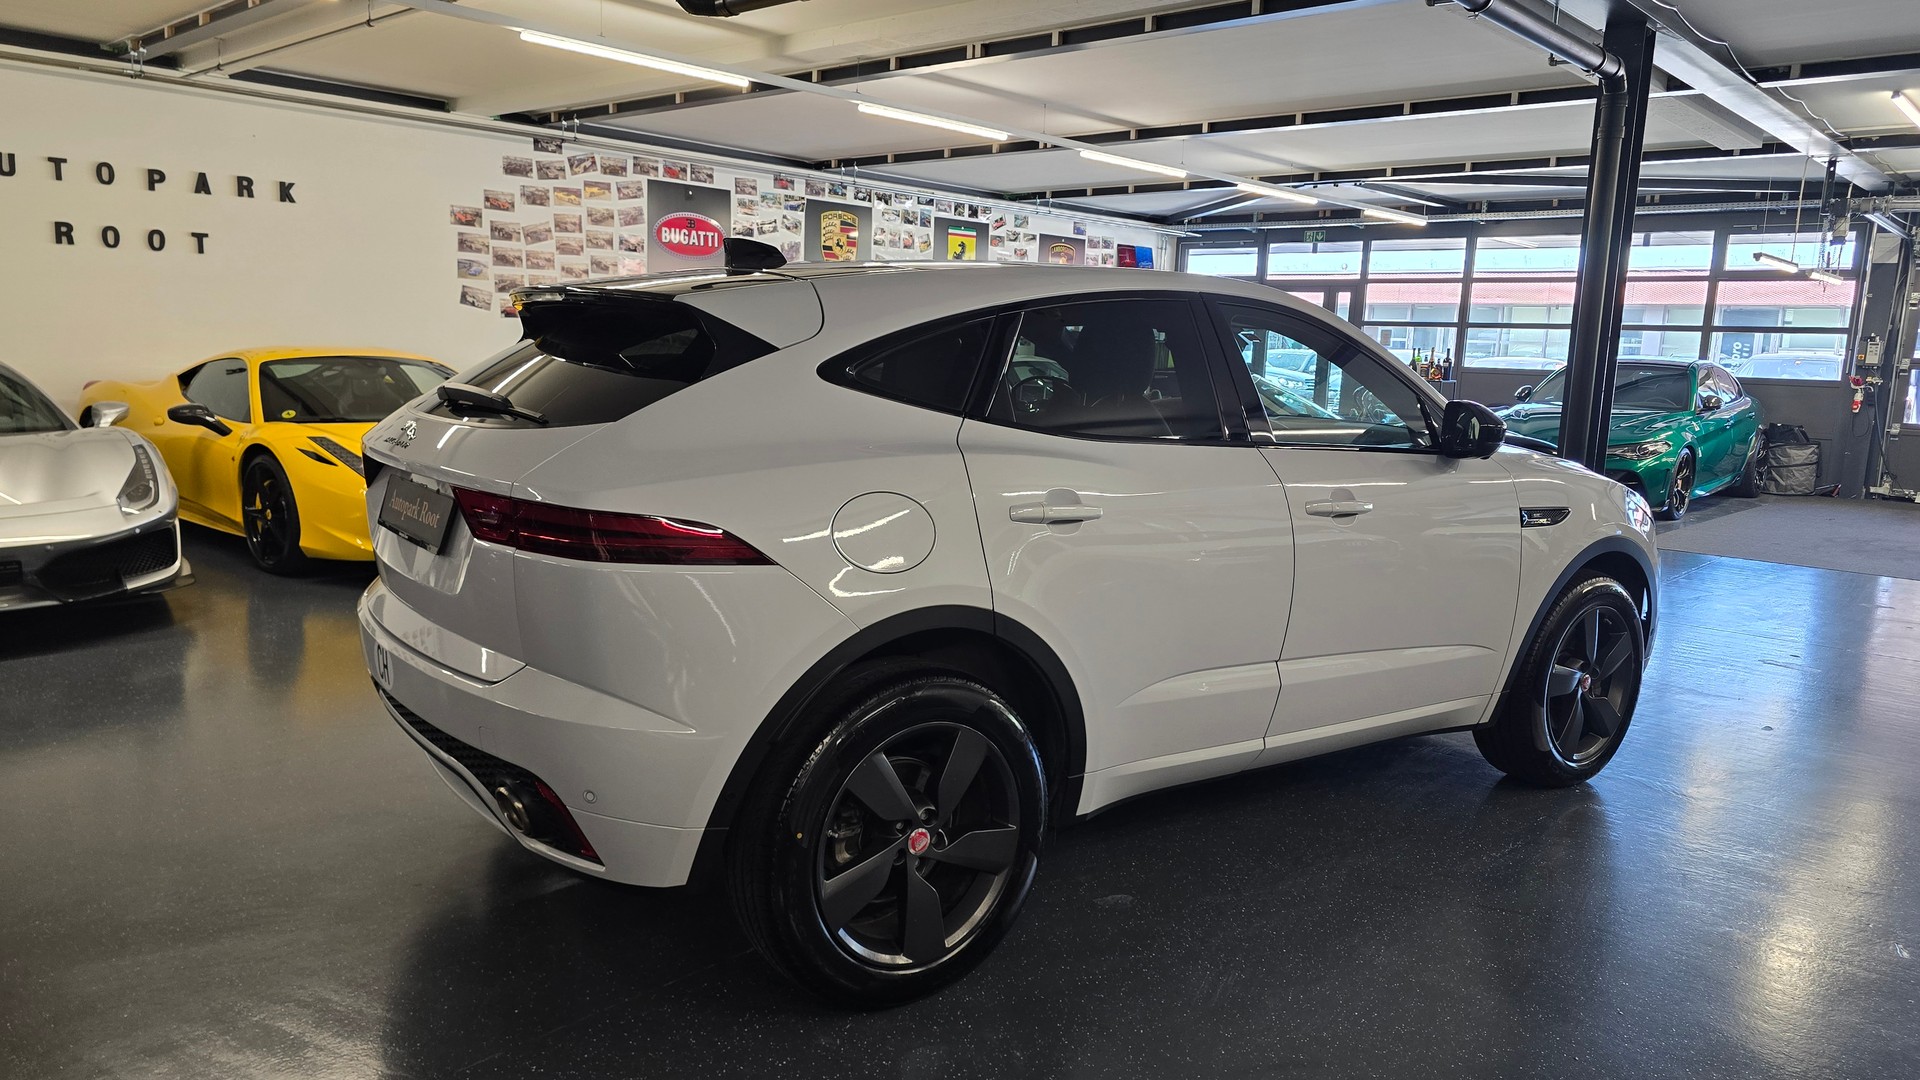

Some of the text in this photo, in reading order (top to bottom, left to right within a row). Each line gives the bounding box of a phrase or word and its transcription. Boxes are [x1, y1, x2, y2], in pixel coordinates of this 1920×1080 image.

[822, 213, 858, 225] PORSCHE
[54, 220, 209, 254] ROOT
[661, 226, 719, 248] BUGATTI
[419, 501, 441, 528] Root
